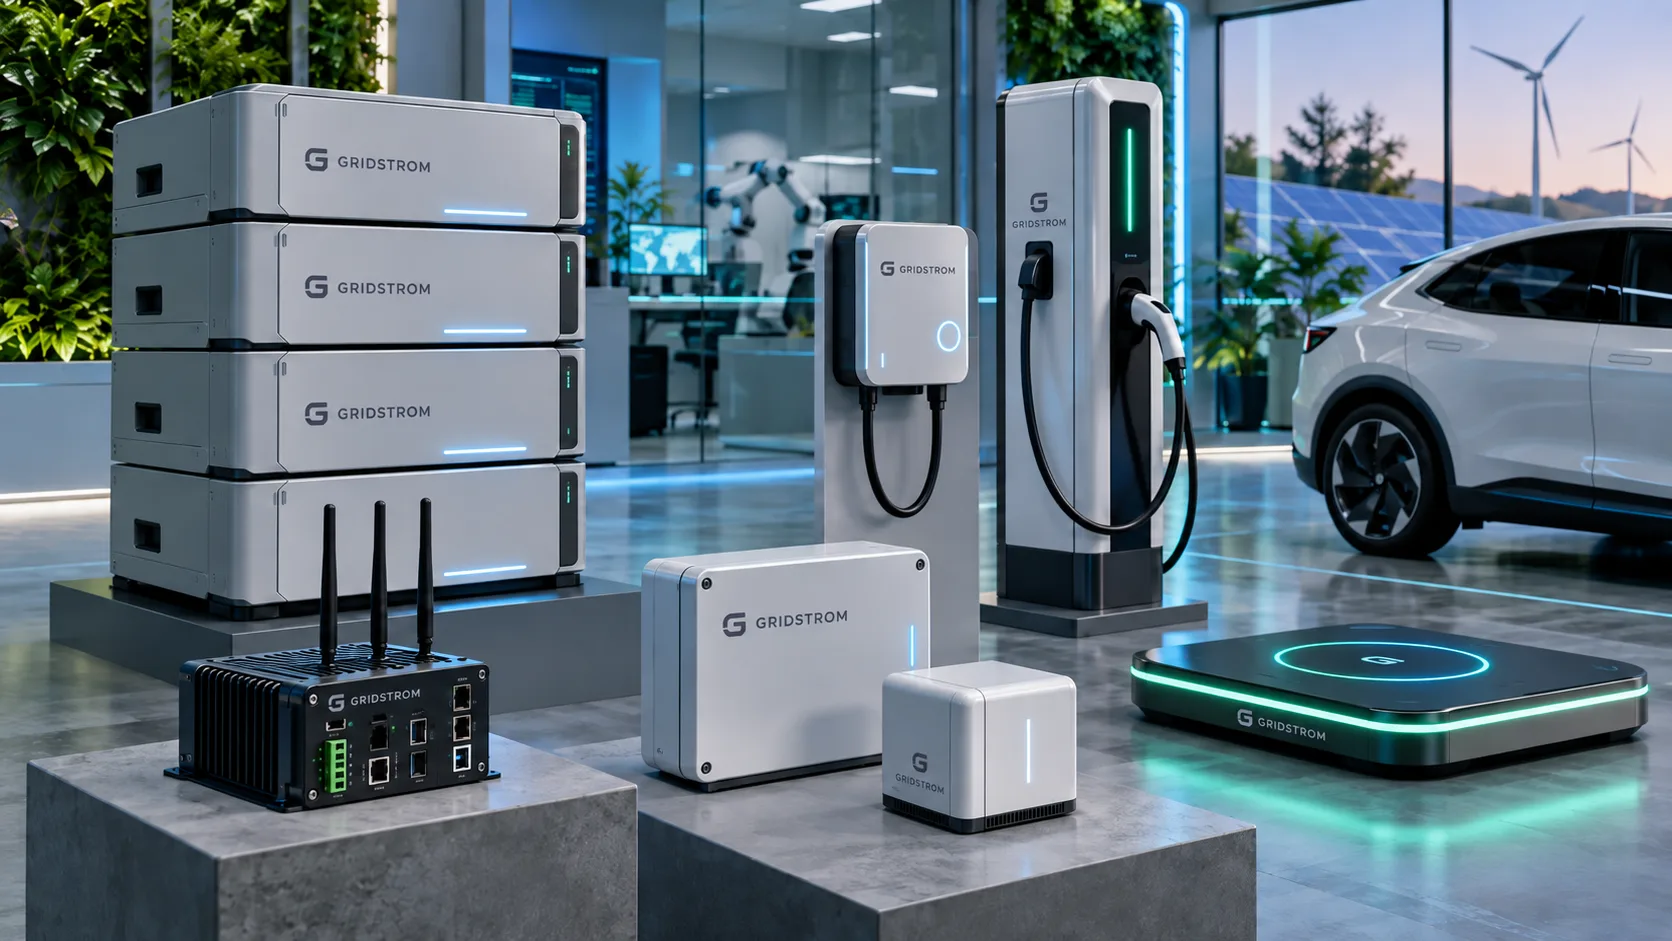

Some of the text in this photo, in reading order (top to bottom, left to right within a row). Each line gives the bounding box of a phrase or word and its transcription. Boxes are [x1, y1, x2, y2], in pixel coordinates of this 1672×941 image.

[337, 156, 431, 173] GRIDSTROM
[1012, 218, 1067, 229] GRIDSTROM
[899, 265, 956, 275] GRIDSTROM
[337, 282, 431, 295] GRIDSTROM
[337, 405, 431, 420] GRIDSTROM
[756, 610, 848, 629] GRIDSTROM
[350, 688, 421, 706] GRIDSTROM
[1258, 717, 1326, 741] GRIDSTROM
[895, 773, 945, 795] GRIDSTROM
